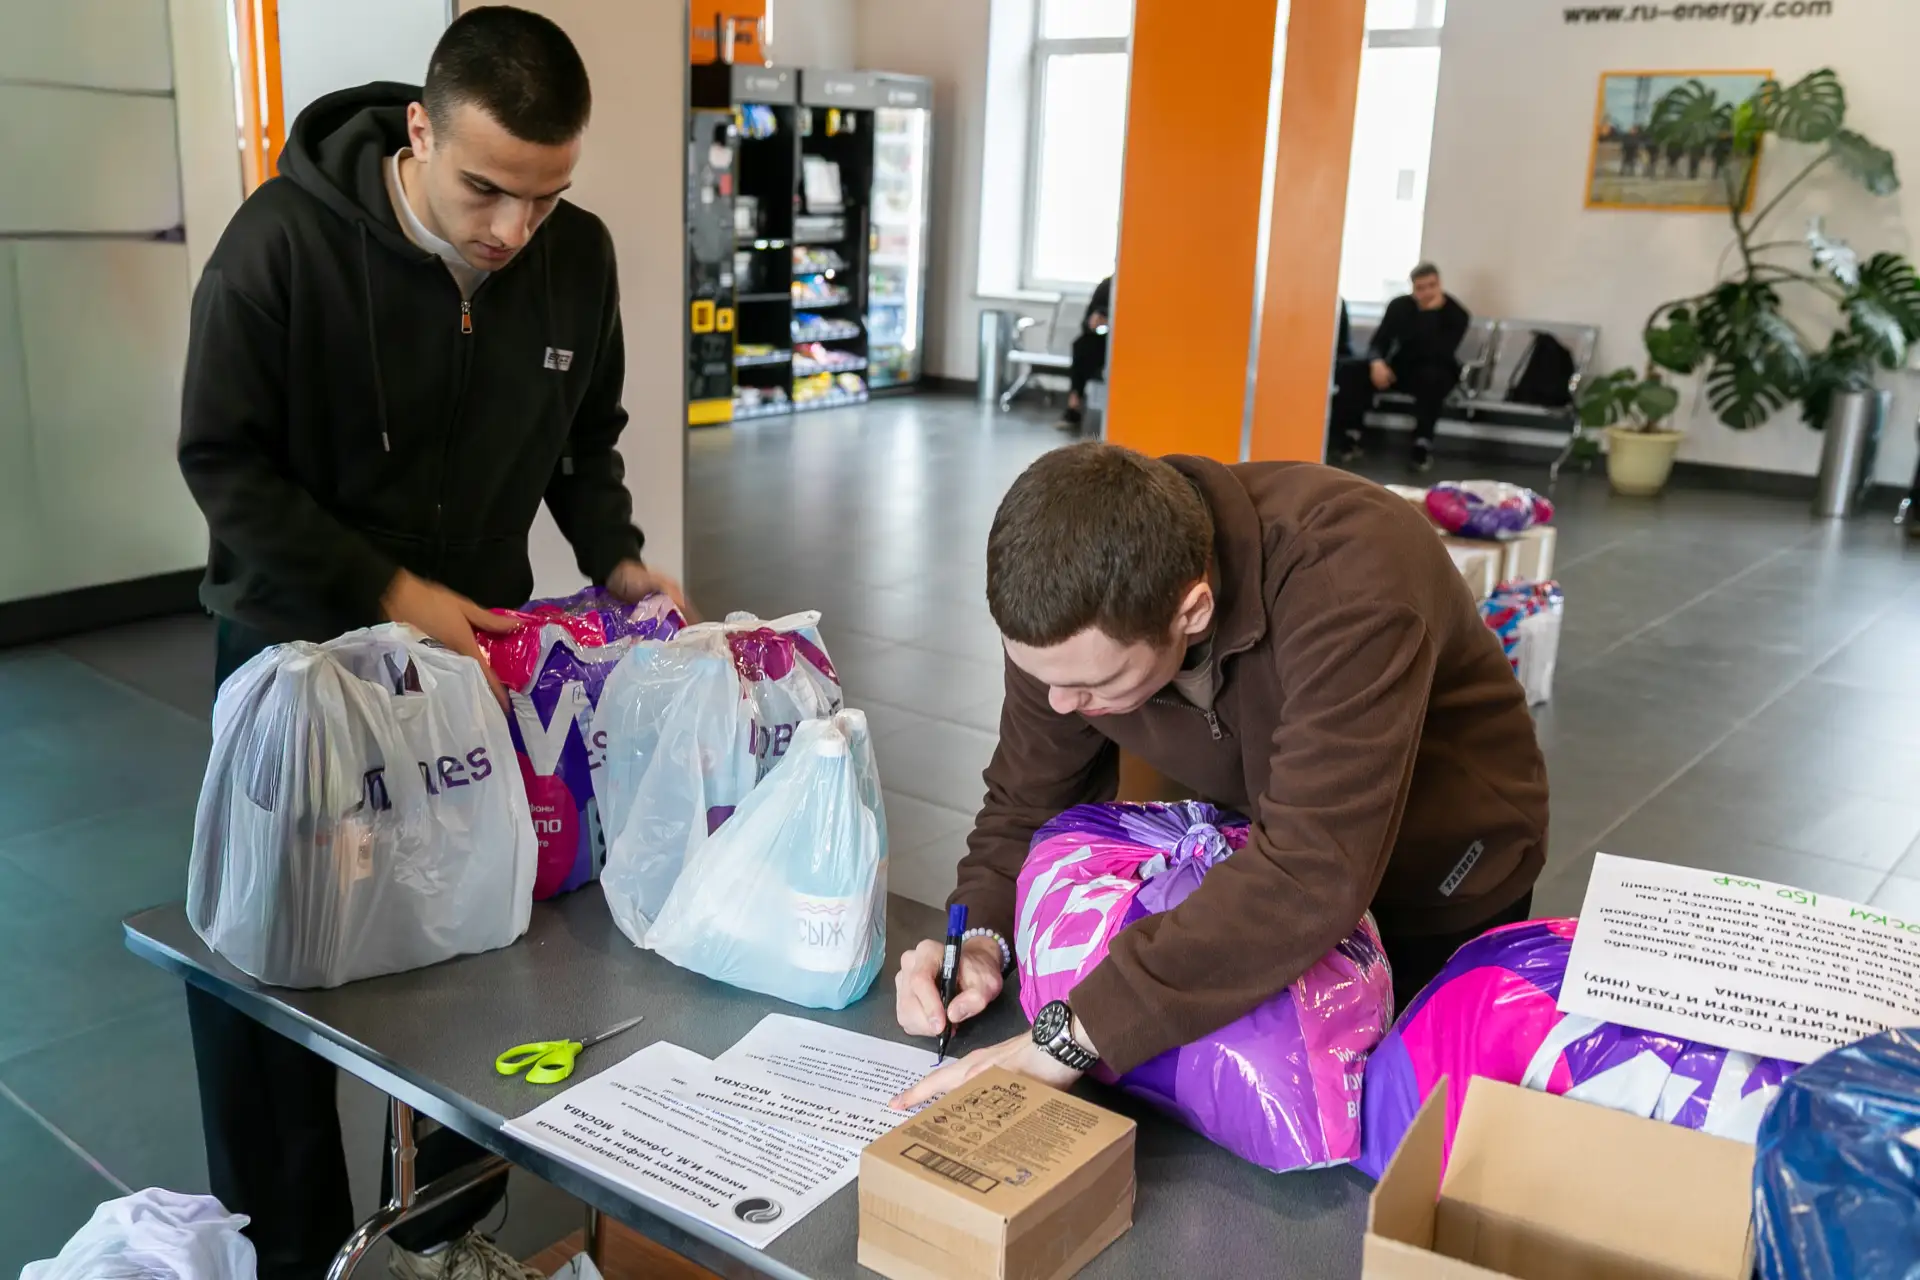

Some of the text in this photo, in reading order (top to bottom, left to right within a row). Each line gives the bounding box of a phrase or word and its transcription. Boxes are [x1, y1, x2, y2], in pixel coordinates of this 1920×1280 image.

[1563, 0, 1833, 25] www.ru-energy.com
[1635, 893, 1656, 901] мы
[1692, 891, 1741, 905] нашей
[1776, 888, 1818, 907] 150
[1599, 906, 1667, 924] Победой!
[1667, 907, 1699, 919] Вас!
[1759, 903, 1796, 916] жить
[1603, 915, 1657, 932] страны
[1687, 921, 1714, 932] Вас
[1705, 913, 1757, 929] хранит
[1764, 915, 1785, 925] Вы
[1791, 921, 1834, 935] когда
[1801, 914, 1855, 931] вместе
[1608, 927, 1695, 950] защищаете
[1662, 927, 1689, 937] для
[1764, 925, 1789, 936] Бог
[1861, 929, 1902, 943] Вами
[1694, 933, 1754, 950] трудное
[1796, 932, 1850, 949] минуту
[1701, 946, 1725, 955] что
[1770, 938, 1857, 962] передовой!
[1774, 950, 1799, 959] что
[1757, 958, 1775, 967] За
[1832, 963, 1848, 972] За
[1864, 960, 1882, 969] на
[1603, 938, 1895, 1007] Вам наши дорогие ВОИНЫ! Спасибо
[1827, 973, 1849, 983] Вы
[1889, 967, 1911, 978] Вы
[1856, 980, 1881, 990] что
[1582, 971, 1867, 1038] ЕРСИТЕТ НЕФТИ И ГАЗА (НИУ)
[1713, 986, 1837, 1019] И.М.ГУБКИНА
[1585, 986, 1846, 1050] ЙСКИЙ ГОСУДАРСТВЕННЫЙ
[710, 1075, 875, 1123] И.М. Губкина, МОСКВА
[731, 1091, 764, 1102] газа
[693, 1090, 874, 1143] ийский государственный
[777, 1104, 825, 1120] нефти
[571, 1123, 602, 1137] газа
[826, 1117, 885, 1135] ерситет
[558, 1103, 748, 1190] имени И.М. Губкина, МОСКВА
[610, 1140, 655, 1162] нефти
[532, 1119, 720, 1208] Российский государственный
[652, 1159, 736, 1199] университет
